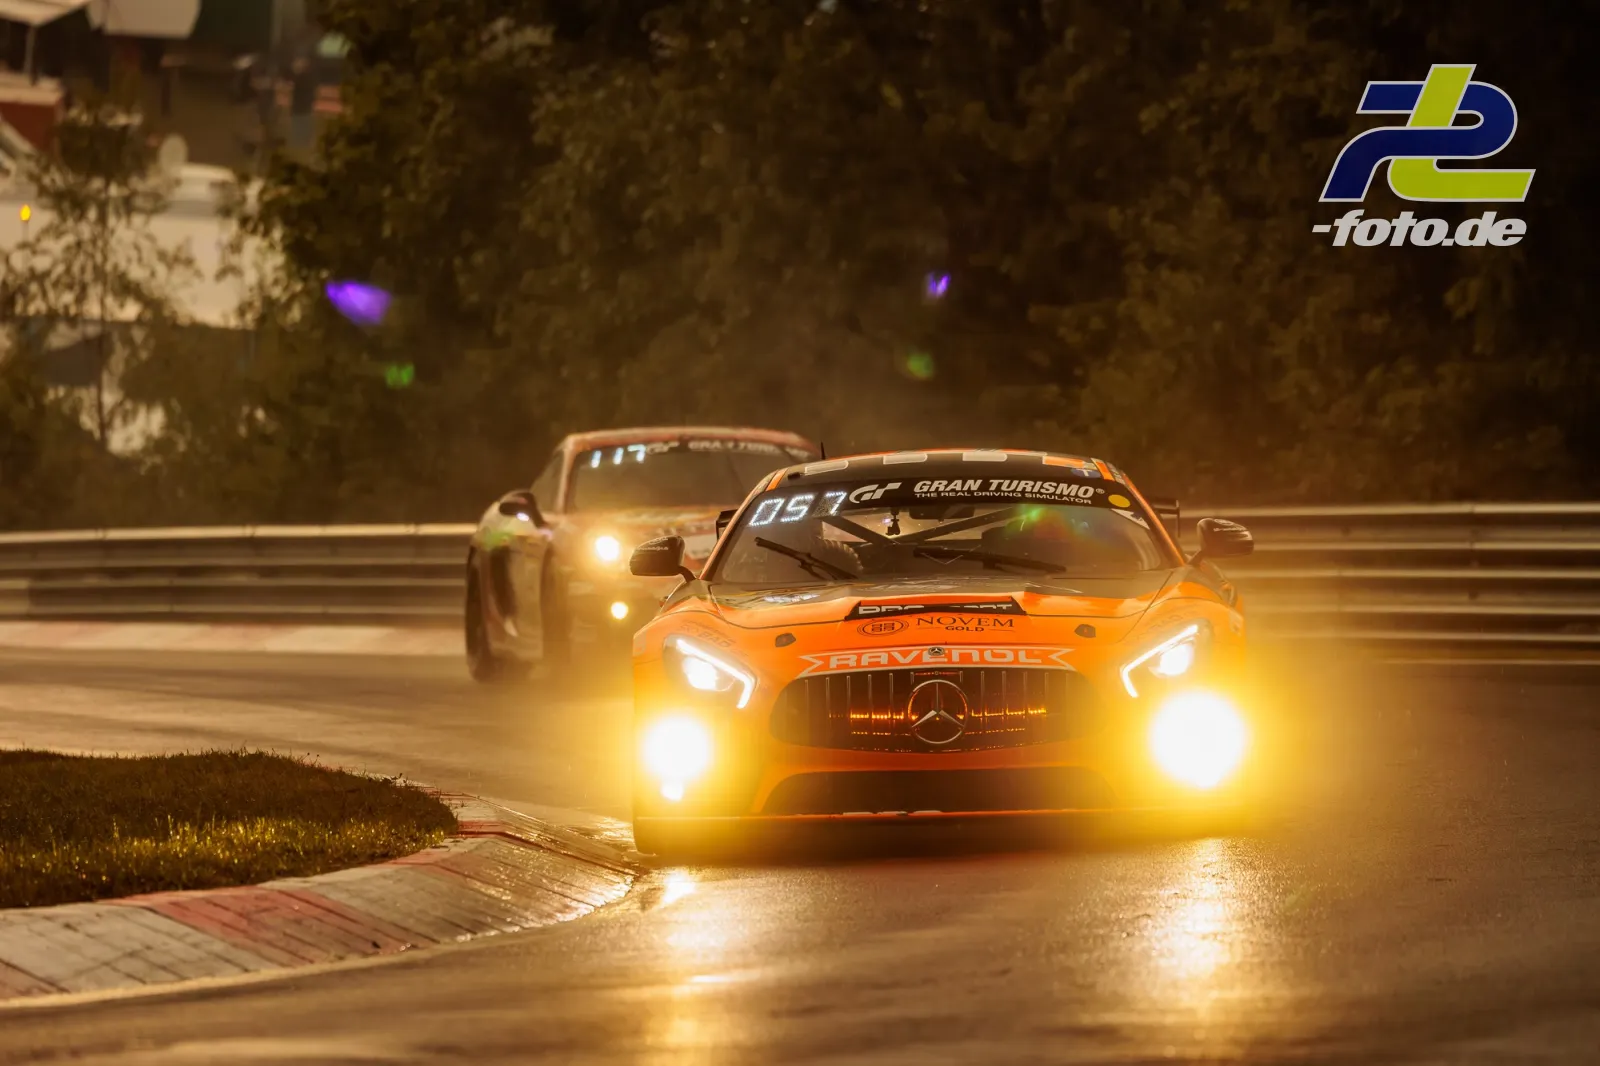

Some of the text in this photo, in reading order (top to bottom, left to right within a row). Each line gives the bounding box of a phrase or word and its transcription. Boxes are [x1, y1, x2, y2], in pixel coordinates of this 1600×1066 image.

[913, 479, 983, 492] GRAN
[1025, 492, 1092, 505] SIMULATOR
[748, 492, 847, 526] 057
[916, 616, 1014, 628] NOVEM
[829, 650, 1042, 669] RAVENOL
